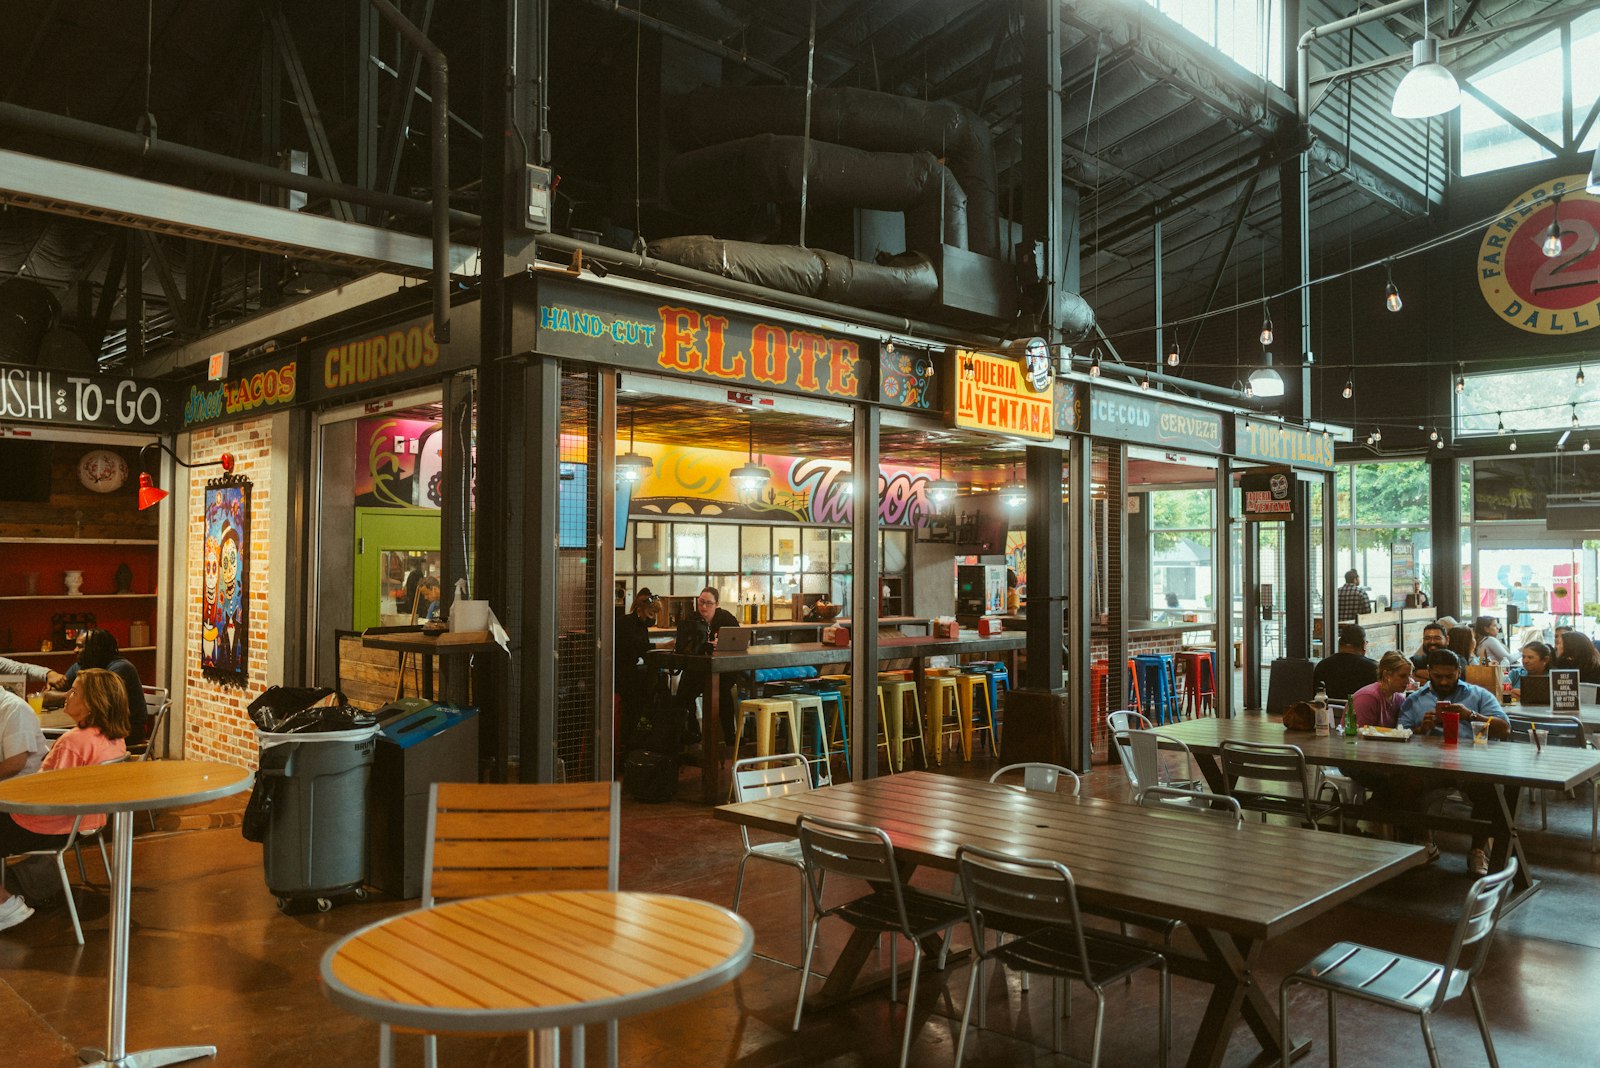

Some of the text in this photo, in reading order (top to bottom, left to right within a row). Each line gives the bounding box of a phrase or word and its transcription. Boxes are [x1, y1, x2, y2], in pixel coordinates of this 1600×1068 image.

[1482, 182, 1566, 280] FARMERS
[1530, 219, 1600, 297] 2
[1504, 300, 1600, 331] DALL
[324, 320, 439, 389] CHURROS
[541, 304, 860, 397] HAND-CUT ELOTE
[67, 376, 162, 425] TO-GO
[184, 360, 297, 427] Street TACOS
[959, 381, 1051, 434] LA VENTANA
[1160, 412, 1218, 440] CERVEZA
[1249, 424, 1333, 467] TORTILLAS
[788, 457, 933, 527] Taos
[1246, 491, 1271, 501] TAQUERIA
[1255, 501, 1291, 513] VENTANA
